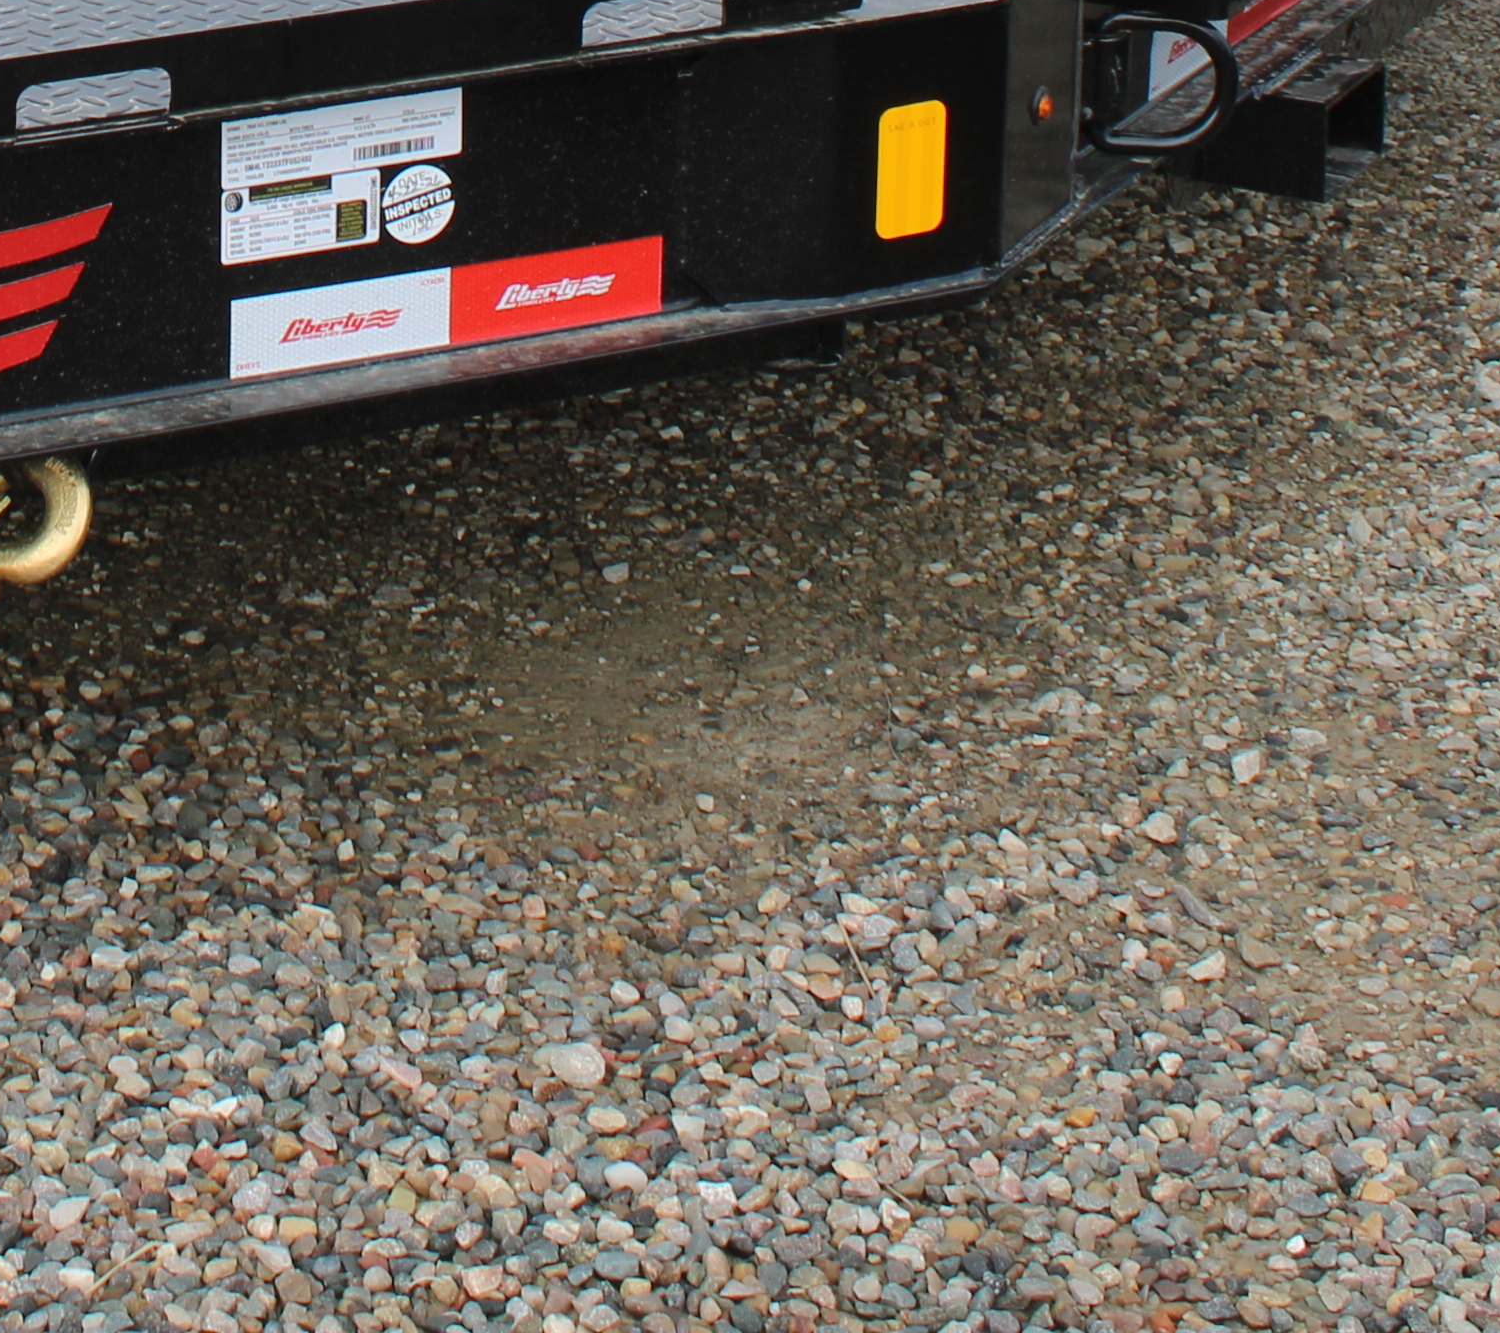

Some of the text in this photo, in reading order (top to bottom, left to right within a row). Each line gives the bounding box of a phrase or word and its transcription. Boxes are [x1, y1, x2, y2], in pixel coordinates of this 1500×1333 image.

[385, 188, 451, 220] INSPECTED
[496, 278, 581, 311] Liberty
[279, 311, 368, 344] Liberty
